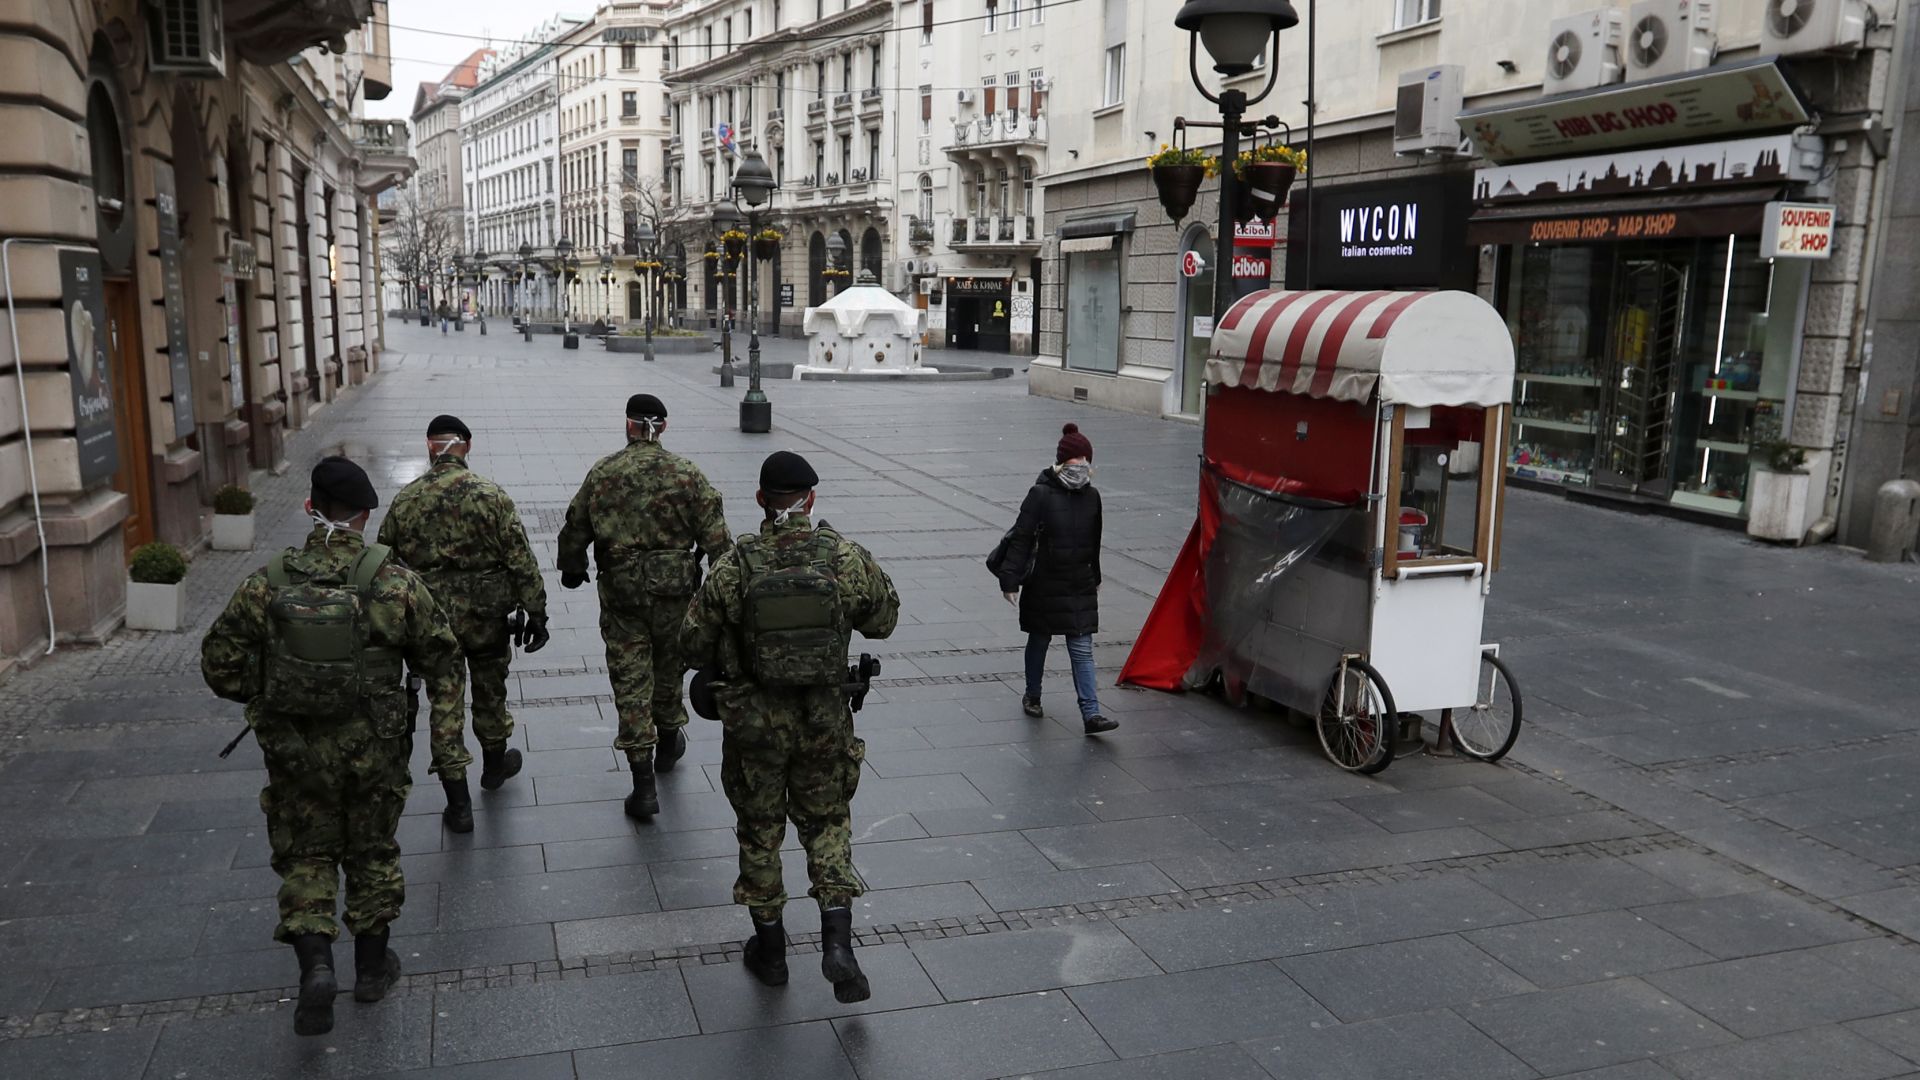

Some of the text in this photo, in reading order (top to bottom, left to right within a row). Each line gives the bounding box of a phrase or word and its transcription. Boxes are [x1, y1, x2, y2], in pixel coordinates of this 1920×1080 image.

[1592, 111, 1626, 133] BG
[1623, 102, 1677, 128] SHOP
[1340, 203, 1417, 243] WYCON
[1530, 221, 1580, 239] SOUVENIR
[1581, 218, 1610, 237] SHOP
[1618, 217, 1643, 236] MAP
[1644, 213, 1676, 235] SHOP
[1782, 210, 1831, 227] SOUVENIR
[1236, 226, 1270, 235] cciban
[1341, 243, 1413, 257] italian cosmetics
[1801, 234, 1828, 250] SHOP
[1232, 257, 1265, 277] iciban
